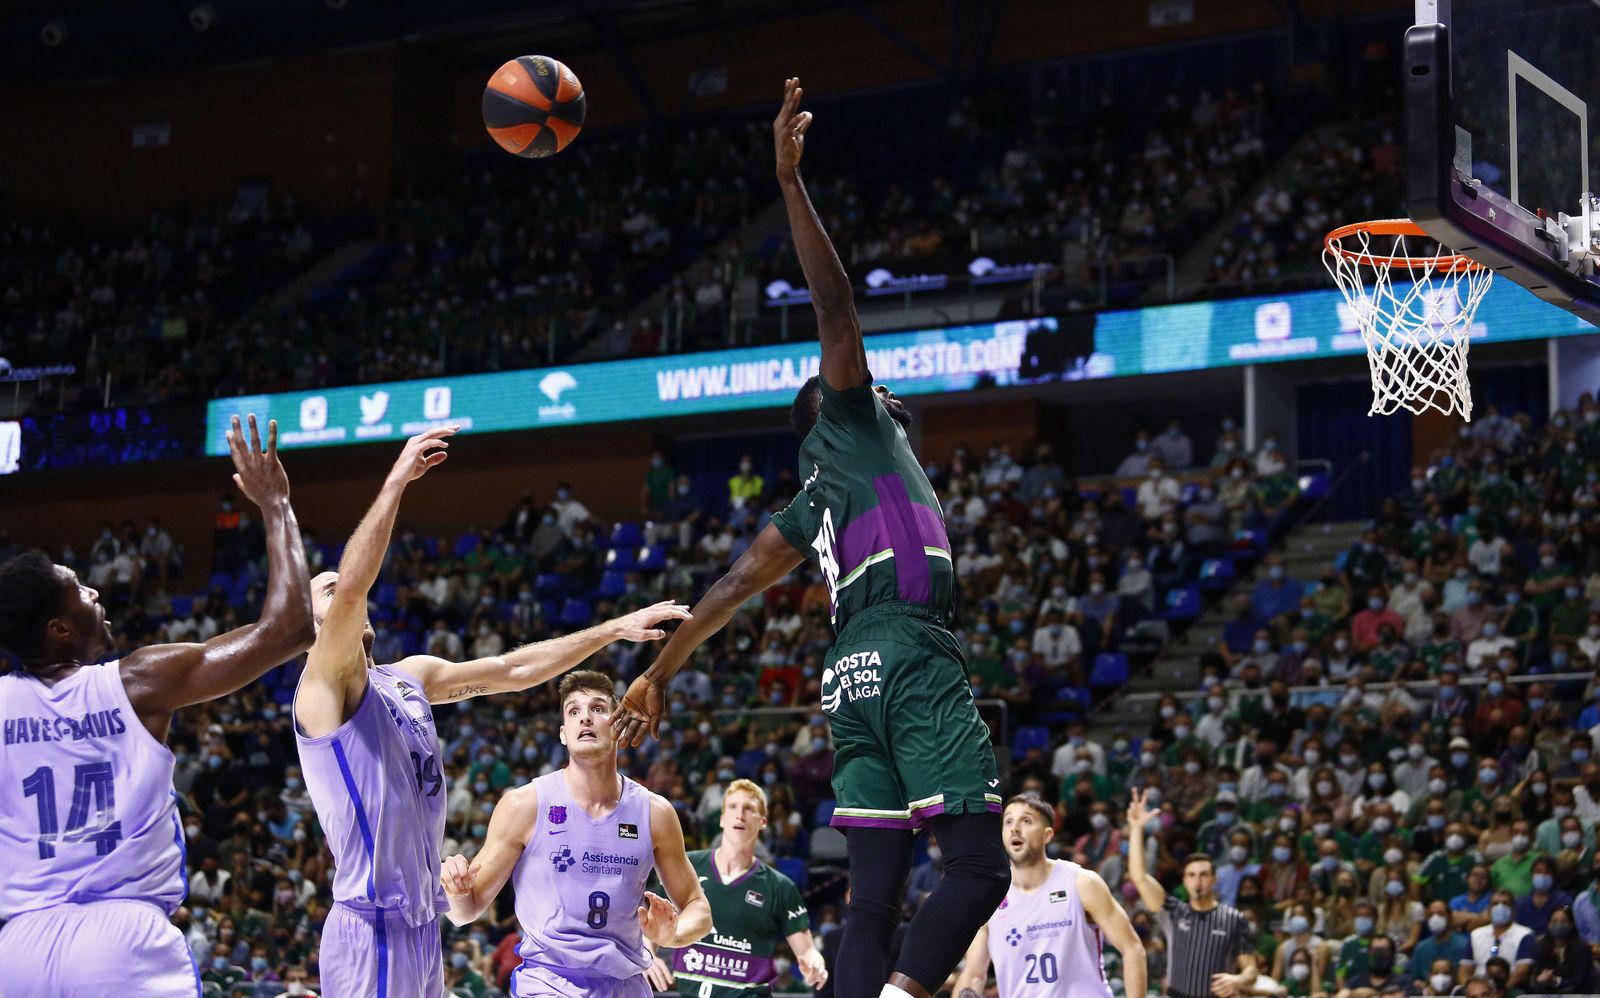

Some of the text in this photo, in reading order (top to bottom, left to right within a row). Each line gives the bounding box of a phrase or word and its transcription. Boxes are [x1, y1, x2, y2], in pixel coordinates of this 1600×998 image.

[834, 650, 882, 676] COSTA
[853, 669, 882, 685] SOL
[447, 684, 489, 700] LUKE
[4, 707, 127, 746] HAYES-DAVIS
[22, 761, 123, 861] 14
[581, 850, 639, 867] Assistència
[581, 862, 622, 876] Sanitària
[586, 890, 611, 930] 8
[713, 934, 752, 951] Unicaja
[1025, 952, 1058, 984] 20
